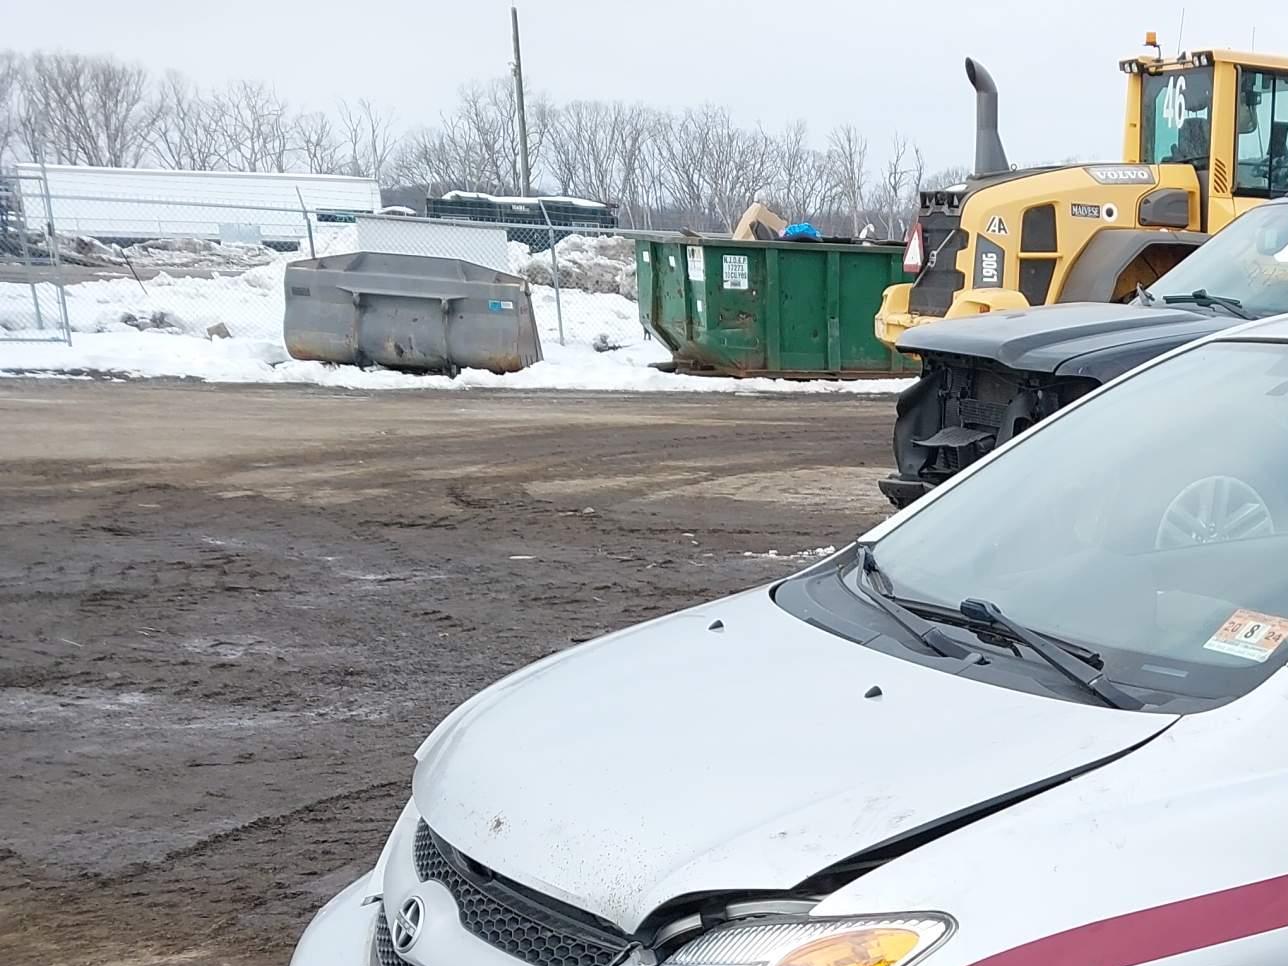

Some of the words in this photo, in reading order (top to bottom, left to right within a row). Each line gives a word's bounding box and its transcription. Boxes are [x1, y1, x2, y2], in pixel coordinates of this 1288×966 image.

[1163, 75, 1187, 129] 46
[1096, 170, 1149, 179] VOLVO
[982, 253, 998, 283] L90G
[1244, 624, 1261, 639] 8
